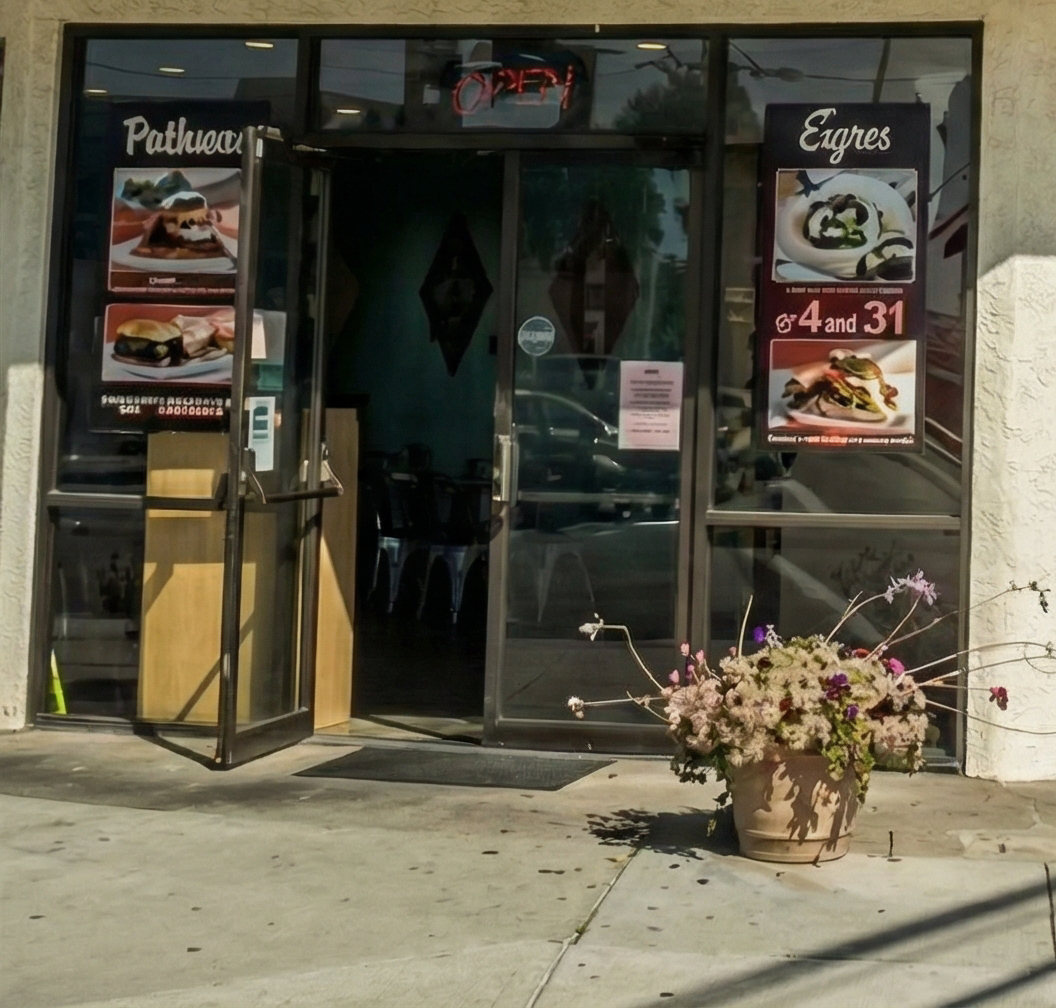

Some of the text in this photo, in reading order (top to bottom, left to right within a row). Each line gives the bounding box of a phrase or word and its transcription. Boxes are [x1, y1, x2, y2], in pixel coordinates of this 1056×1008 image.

[798, 299, 822, 333] 4
[825, 313, 857, 333] and
[863, 300, 904, 335] 31
